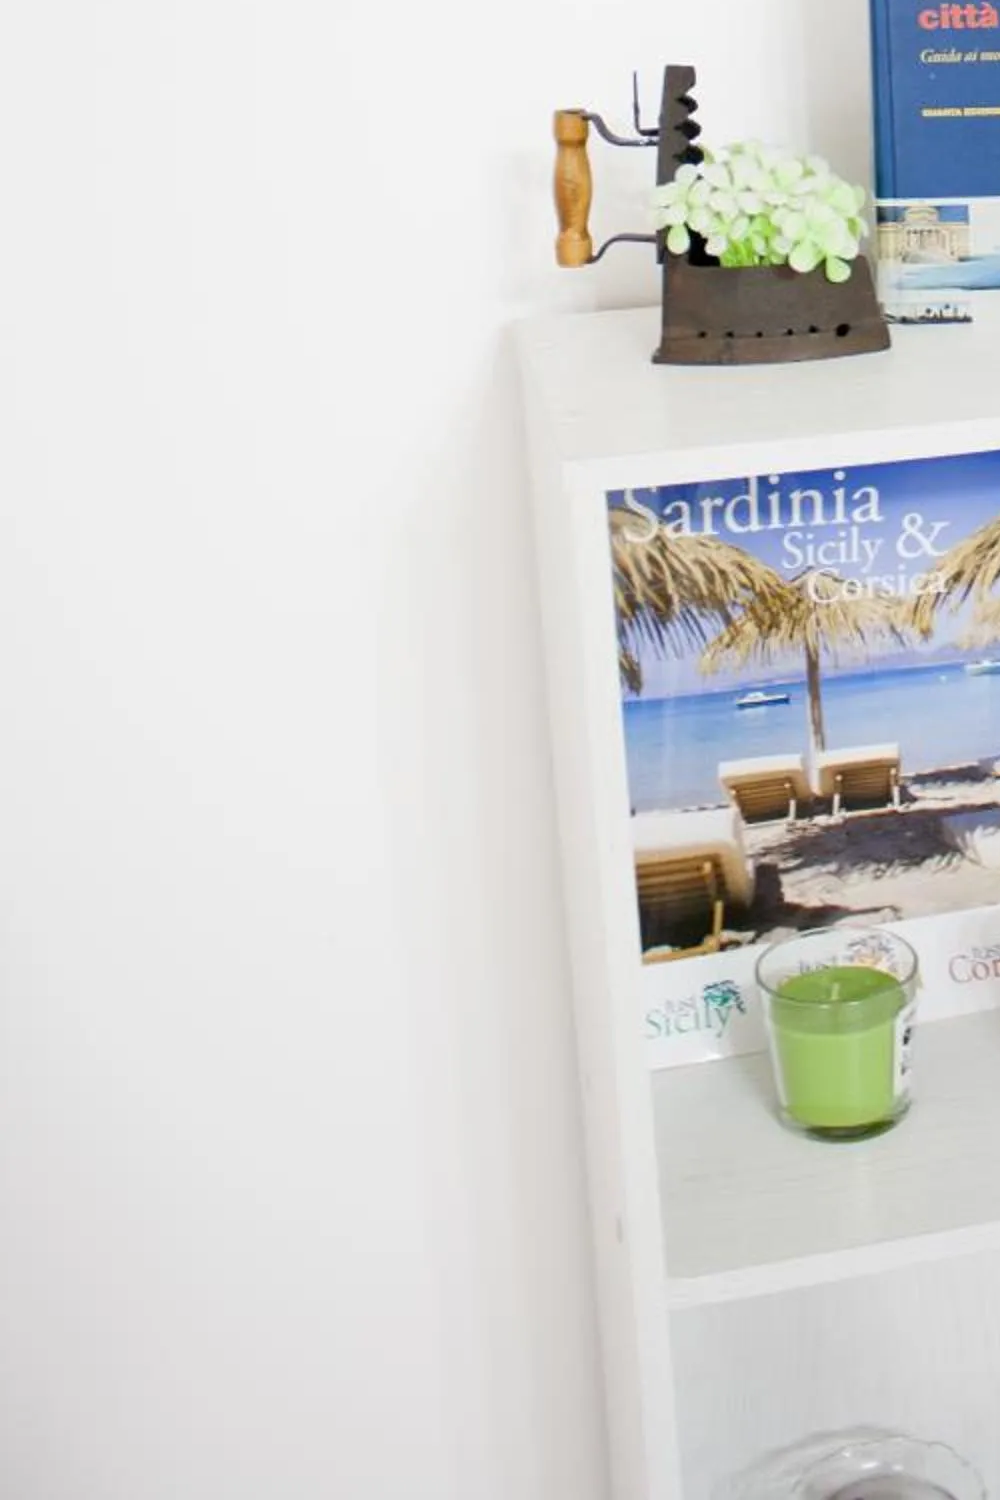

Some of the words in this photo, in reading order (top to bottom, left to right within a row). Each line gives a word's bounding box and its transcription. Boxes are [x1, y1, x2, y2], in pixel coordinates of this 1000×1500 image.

[917, 2, 998, 29] città
[920, 48, 962, 64] Guida
[621, 470, 883, 544] Sardinia
[781, 526, 884, 574] Sicily
[895, 512, 951, 559] &
[807, 564, 949, 604] Corsica
